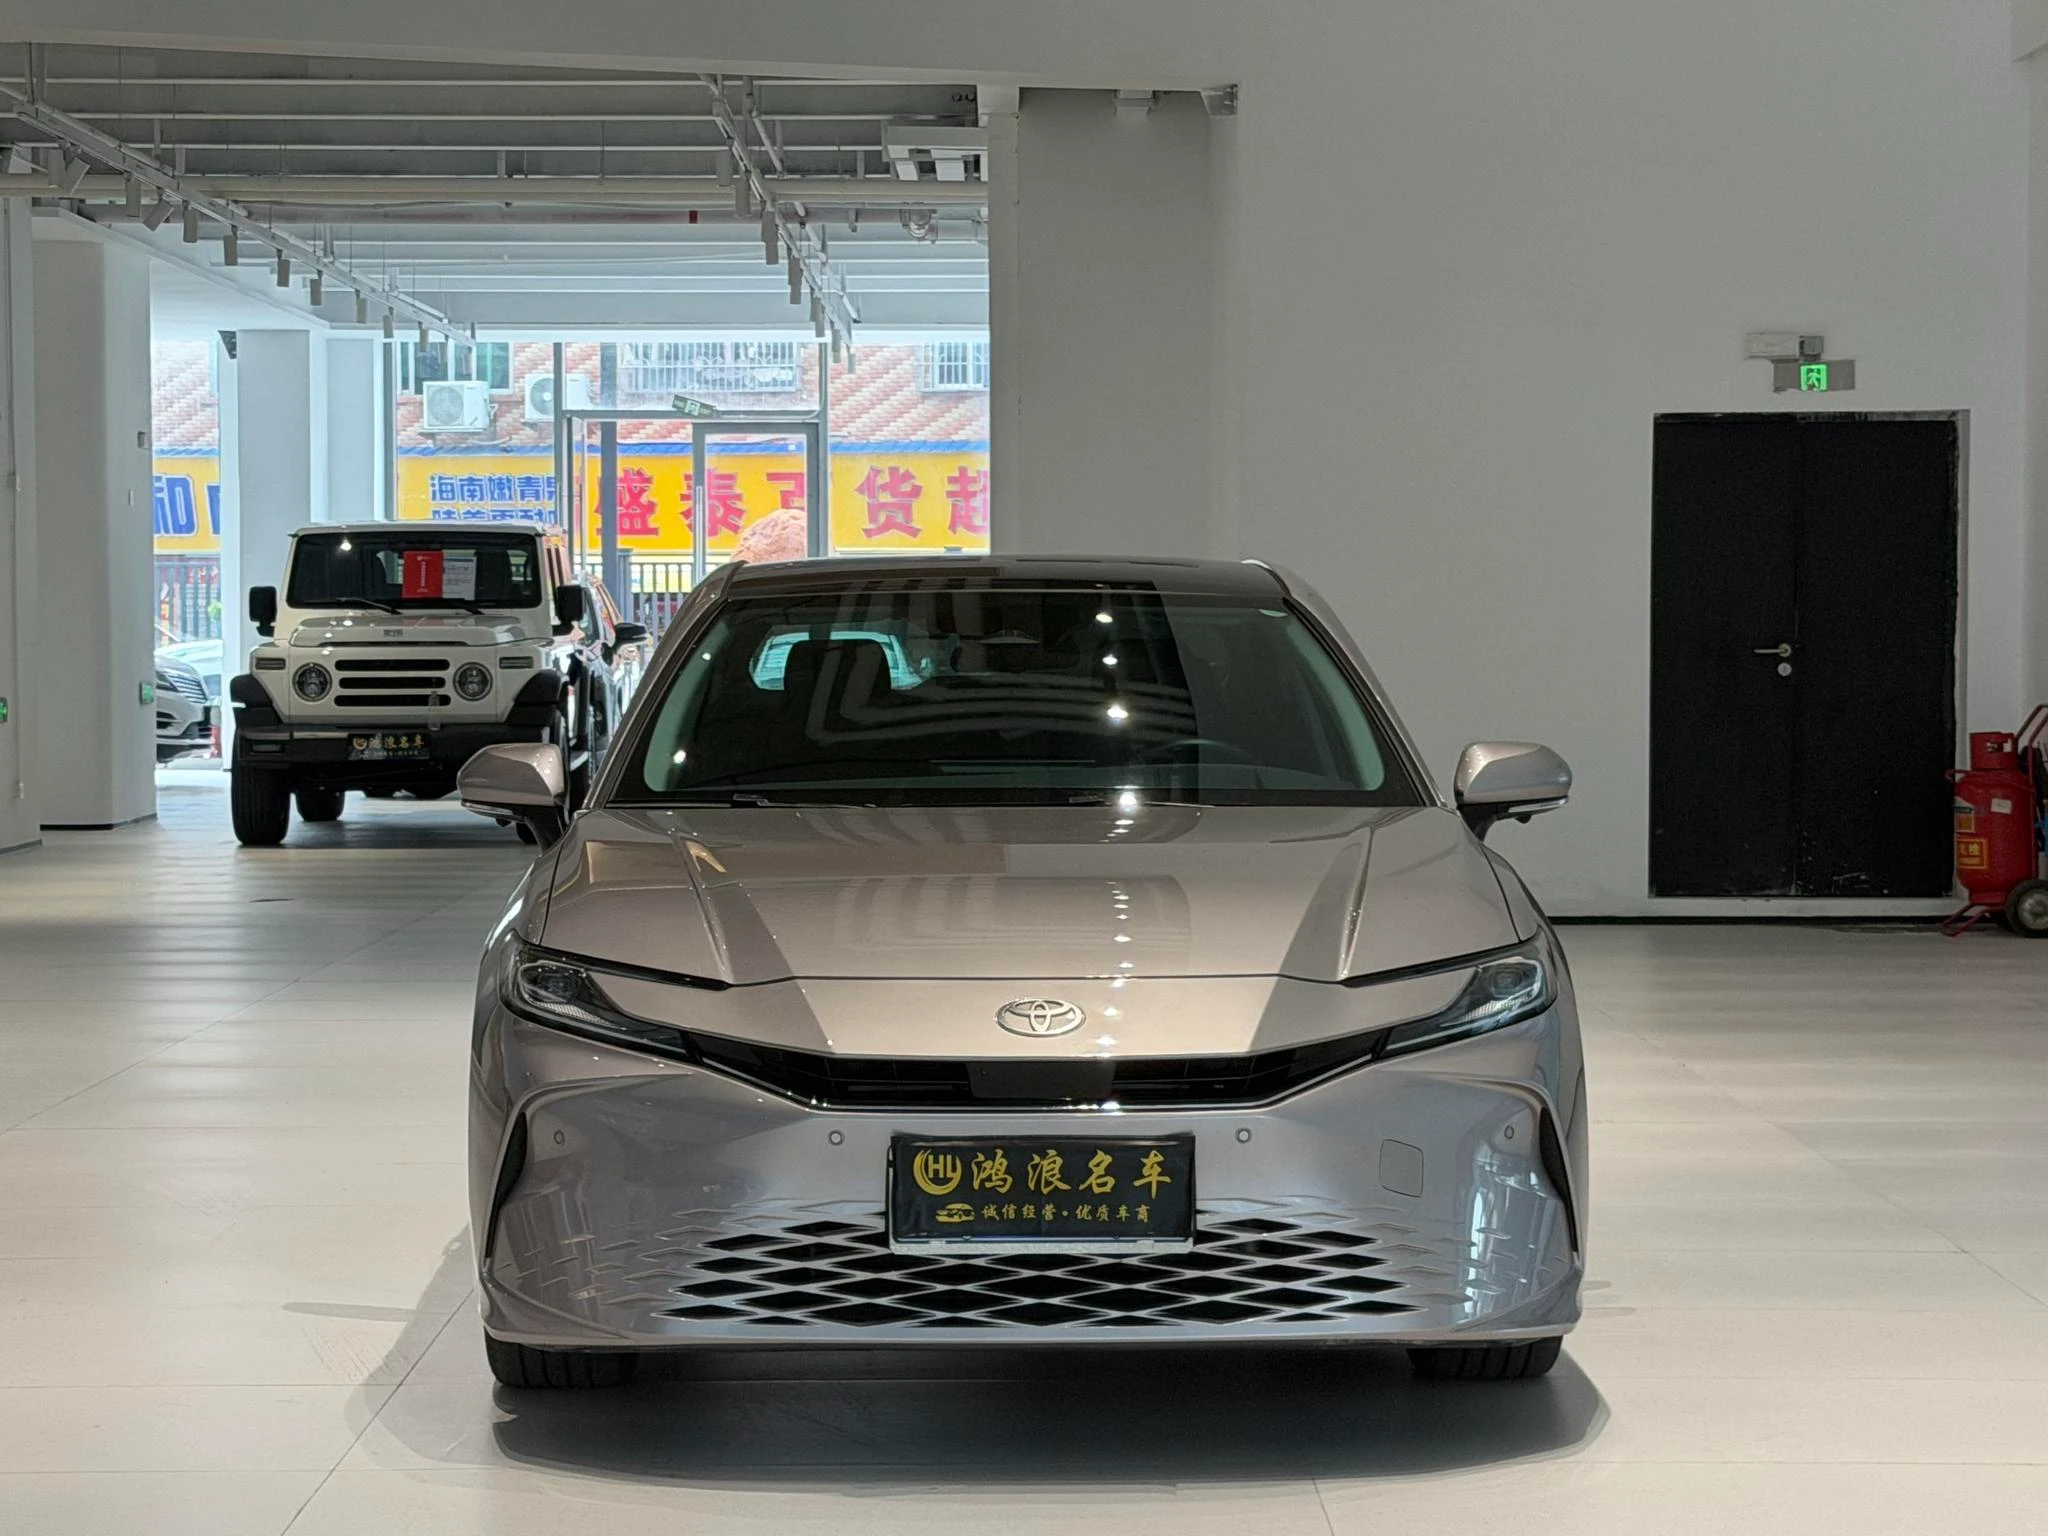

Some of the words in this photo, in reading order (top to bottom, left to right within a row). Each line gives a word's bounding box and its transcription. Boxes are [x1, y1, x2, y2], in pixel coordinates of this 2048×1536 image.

[153, 474, 221, 536] 和
[971, 1147, 1173, 1200] 鸿浪名车
